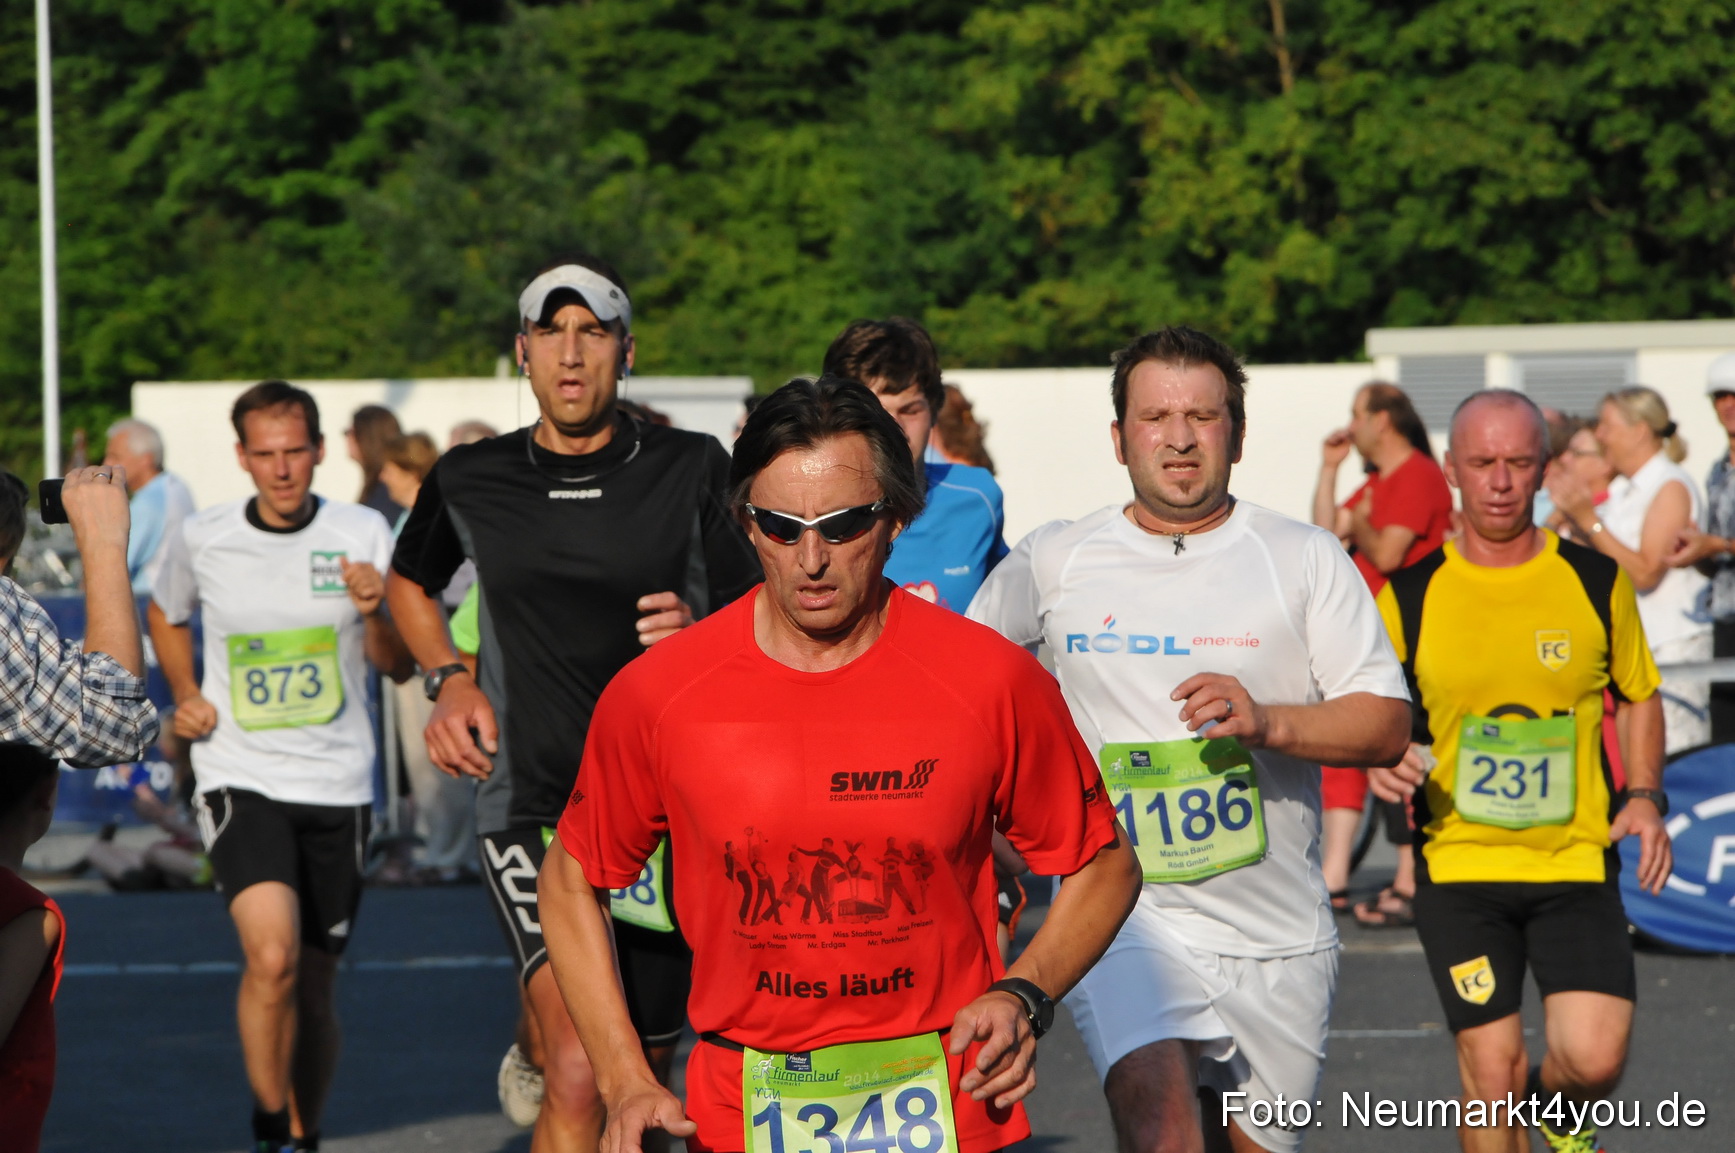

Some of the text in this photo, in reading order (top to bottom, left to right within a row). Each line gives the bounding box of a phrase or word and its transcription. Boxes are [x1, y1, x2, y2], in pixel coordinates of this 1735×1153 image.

[1192, 632, 1260, 648] energie
[1542, 642, 1566, 659] FC
[246, 663, 323, 705] 873
[830, 769, 903, 792] swn
[1470, 756, 1549, 799] 231
[829, 790, 923, 802] stadtwerke neumarkt
[1115, 779, 1253, 847] 1186
[1159, 843, 1215, 858] Markus Baum
[1186, 857, 1210, 868] GmbH
[850, 930, 883, 938] Stadtbus
[897, 919, 934, 933] Miss Freizeit
[821, 941, 847, 950] Erdgas
[867, 935, 910, 947] Mr. Parkhaus
[755, 966, 914, 999] Alles läuft
[1461, 969, 1489, 994] FC
[773, 1068, 880, 1087] firmenlauf 2014
[752, 1086, 945, 1153] 1348
